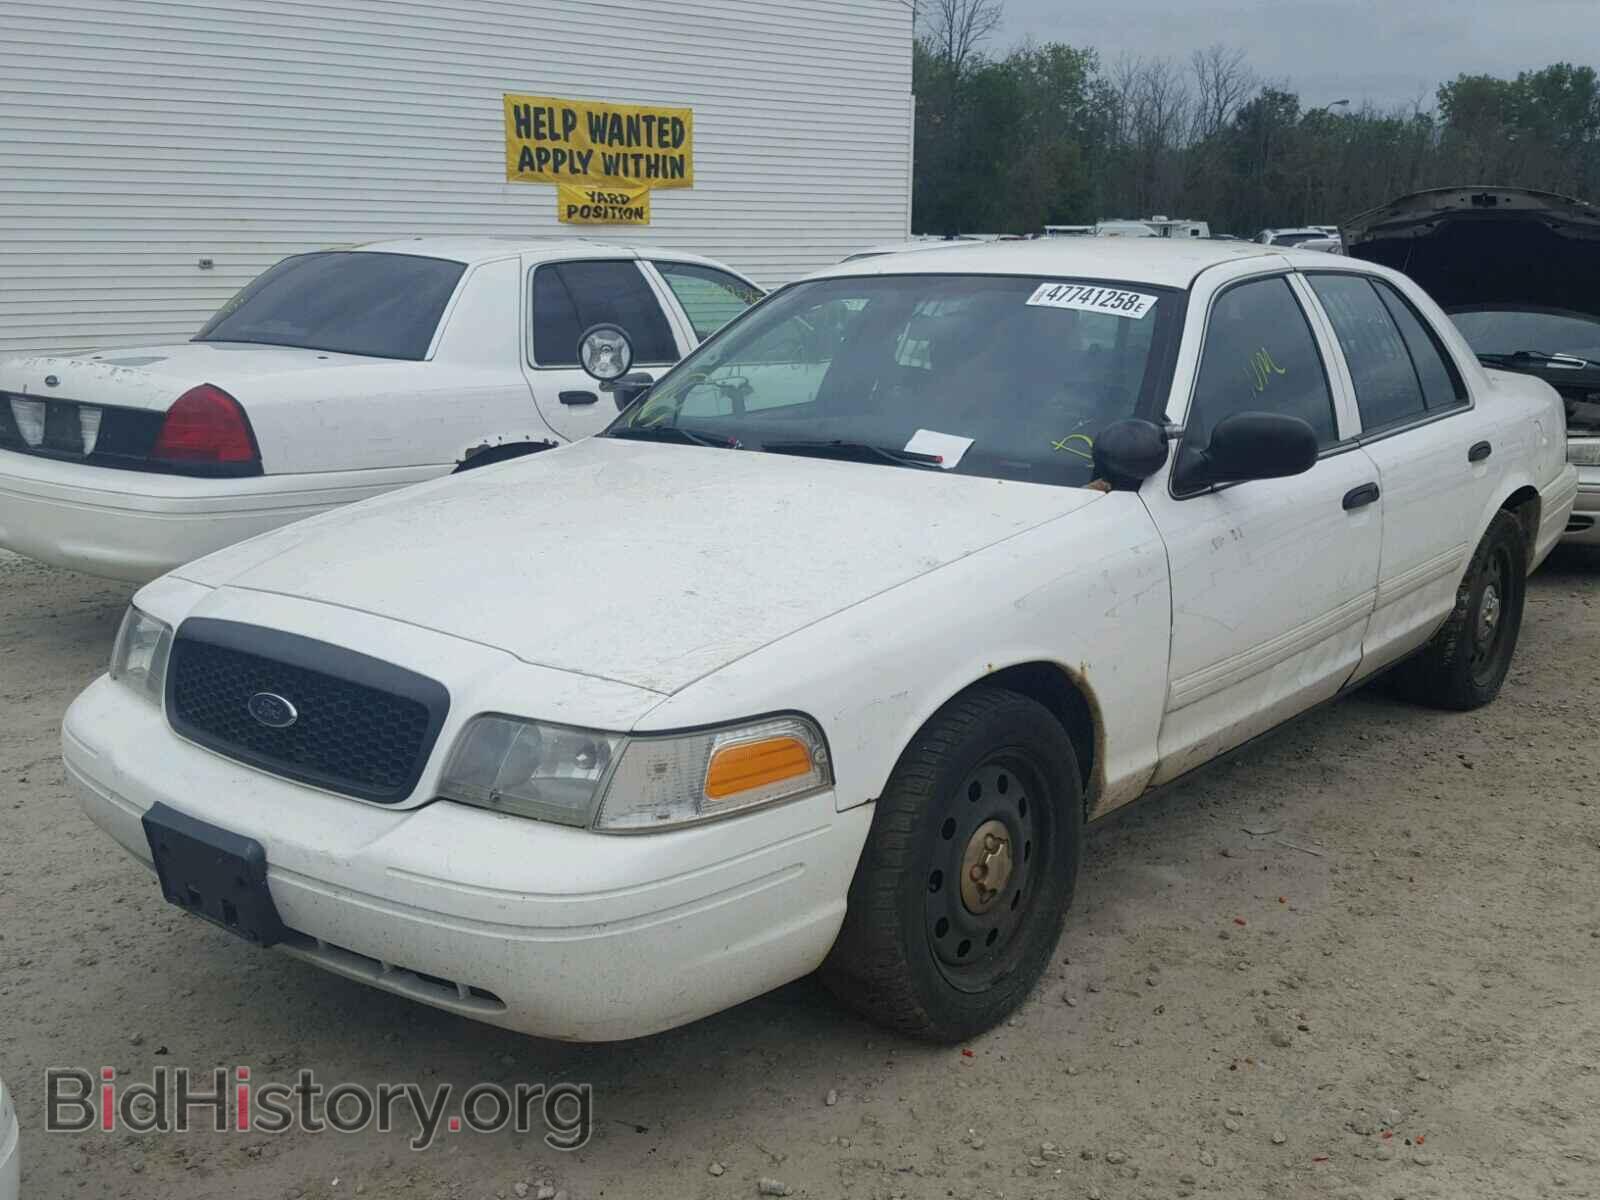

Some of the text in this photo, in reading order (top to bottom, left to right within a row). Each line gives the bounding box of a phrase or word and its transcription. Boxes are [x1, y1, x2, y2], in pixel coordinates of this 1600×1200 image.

[513, 104, 686, 149] HELP WANTED
[517, 145, 685, 179] APPLY WITHIN
[585, 191, 630, 205] YARD
[567, 204, 644, 220] POSITION
